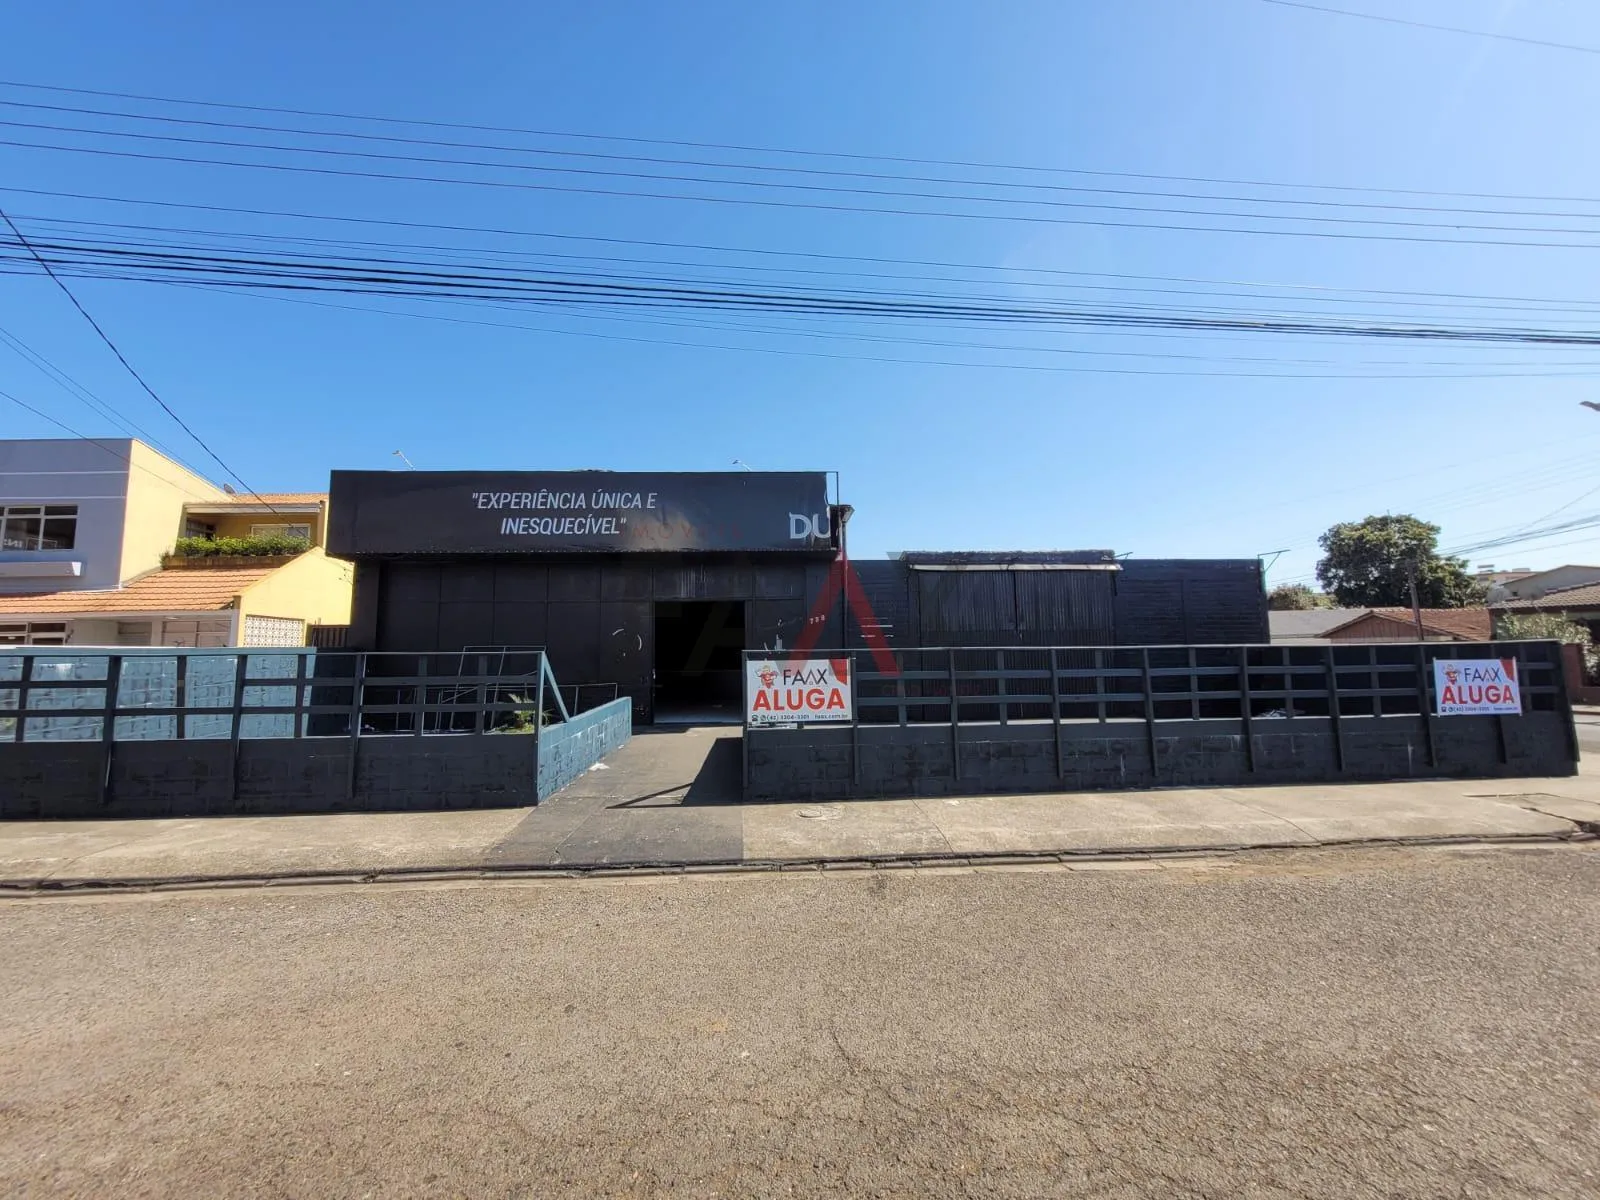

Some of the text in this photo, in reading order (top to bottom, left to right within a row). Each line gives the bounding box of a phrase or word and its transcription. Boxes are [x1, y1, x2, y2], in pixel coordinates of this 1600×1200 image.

[472, 488, 658, 509] "EXPERIÊNCIA ÚNICA E
[500, 514, 628, 535] INESQUECÍVEL"
[753, 688, 846, 711] ALUGA
[1442, 685, 1514, 705] ALUGA
